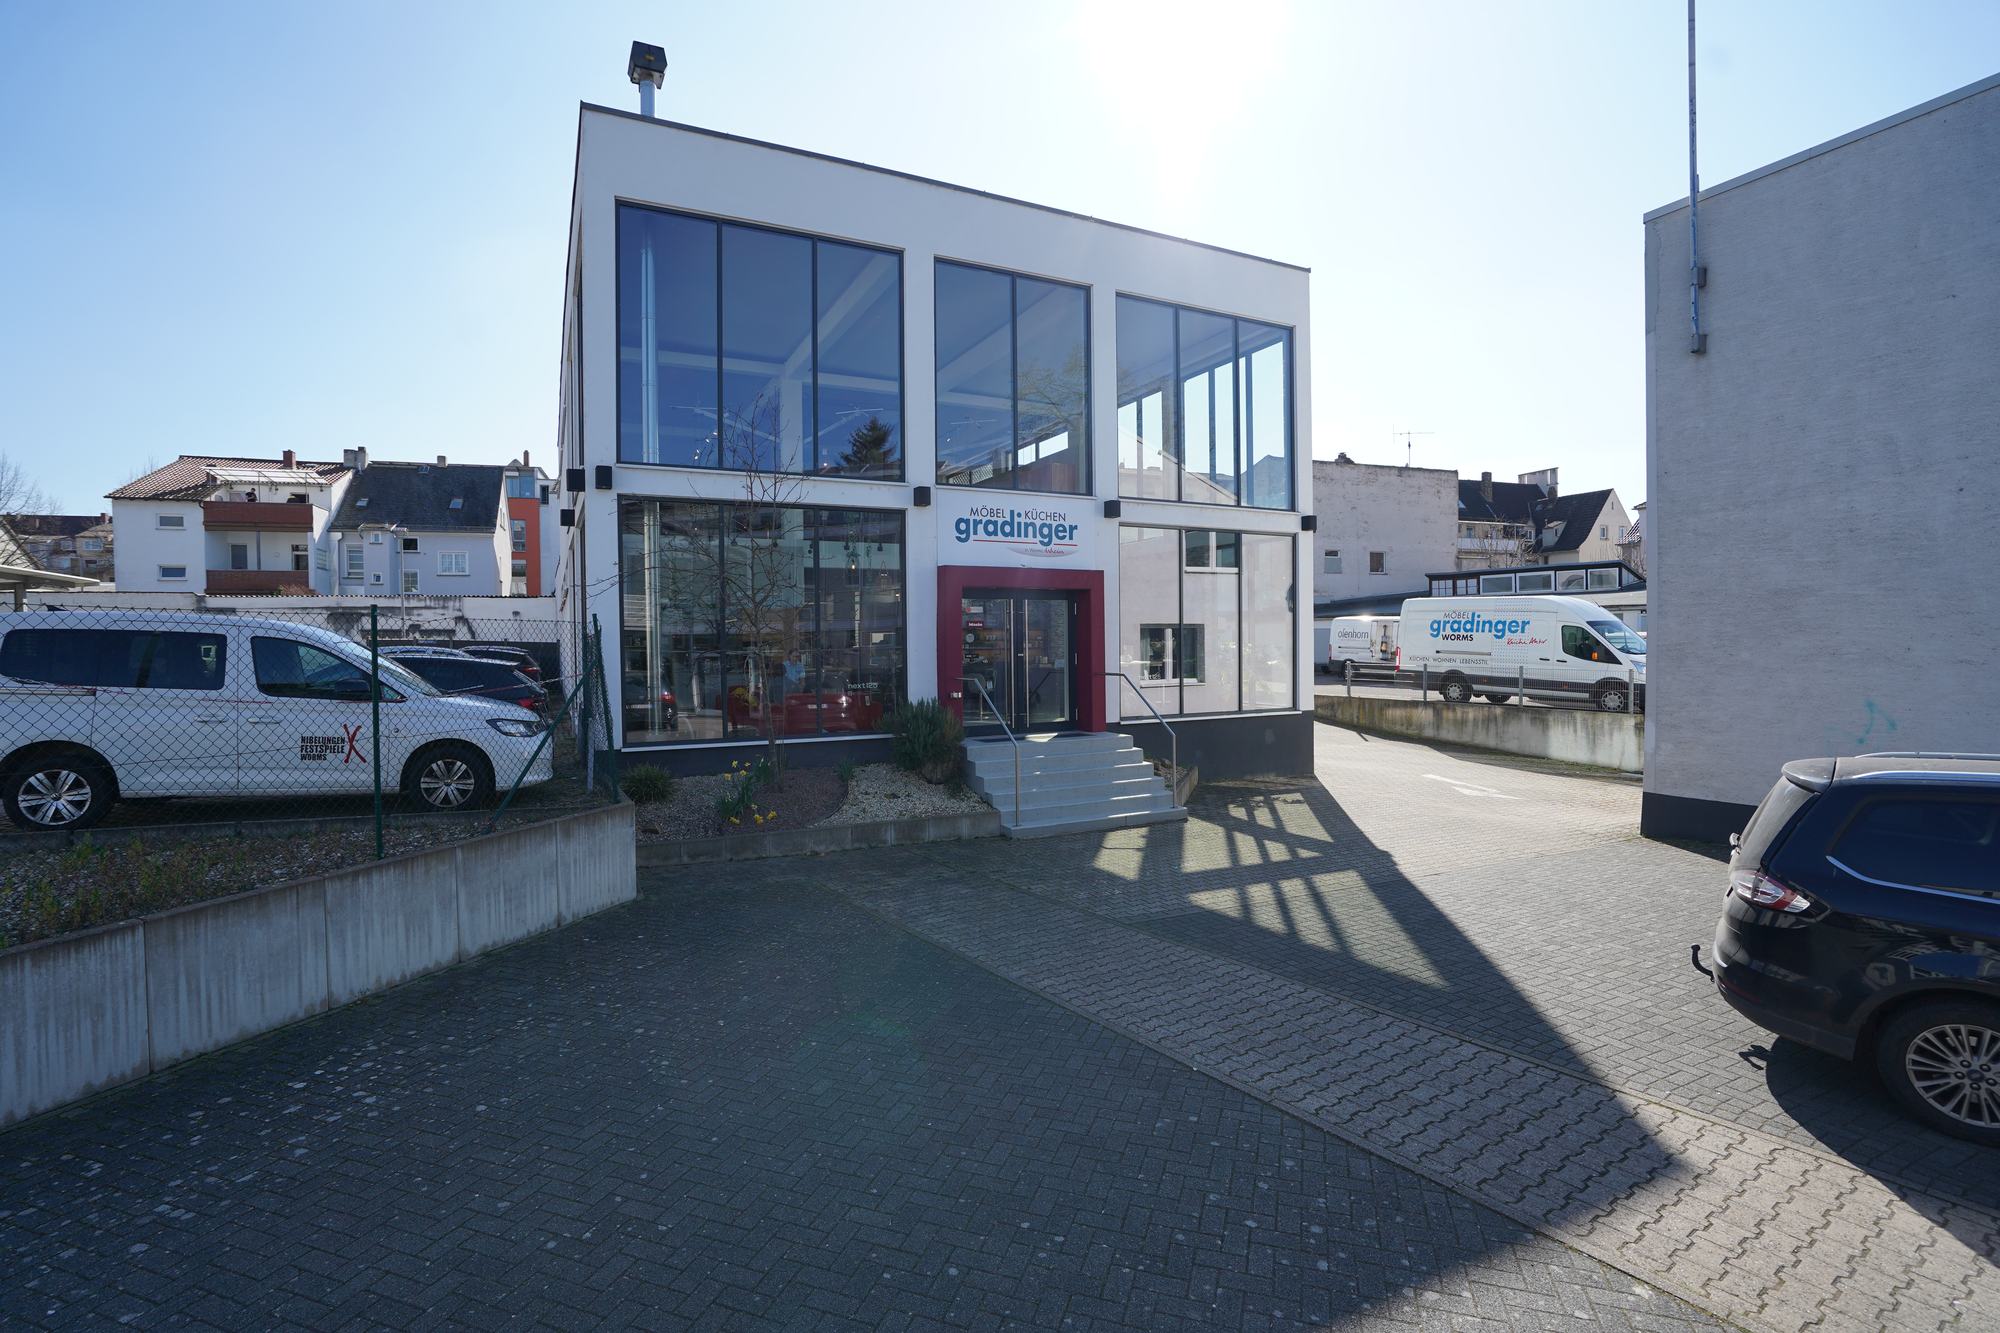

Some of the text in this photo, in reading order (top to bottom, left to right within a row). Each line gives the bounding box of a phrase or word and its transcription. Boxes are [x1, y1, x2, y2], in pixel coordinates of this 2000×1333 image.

[969, 505, 1066, 522] MÖBEL KÜCHEN
[954, 510, 1078, 547] gradinger
[1443, 611, 1470, 620] MÖBEL
[1429, 612, 1531, 640] gradinger
[1441, 633, 1474, 642] WORMS
[300, 735, 346, 745] NIBELUNGEN
[300, 744, 346, 754] FESTSPIELE
[300, 753, 328, 761] WORMS
